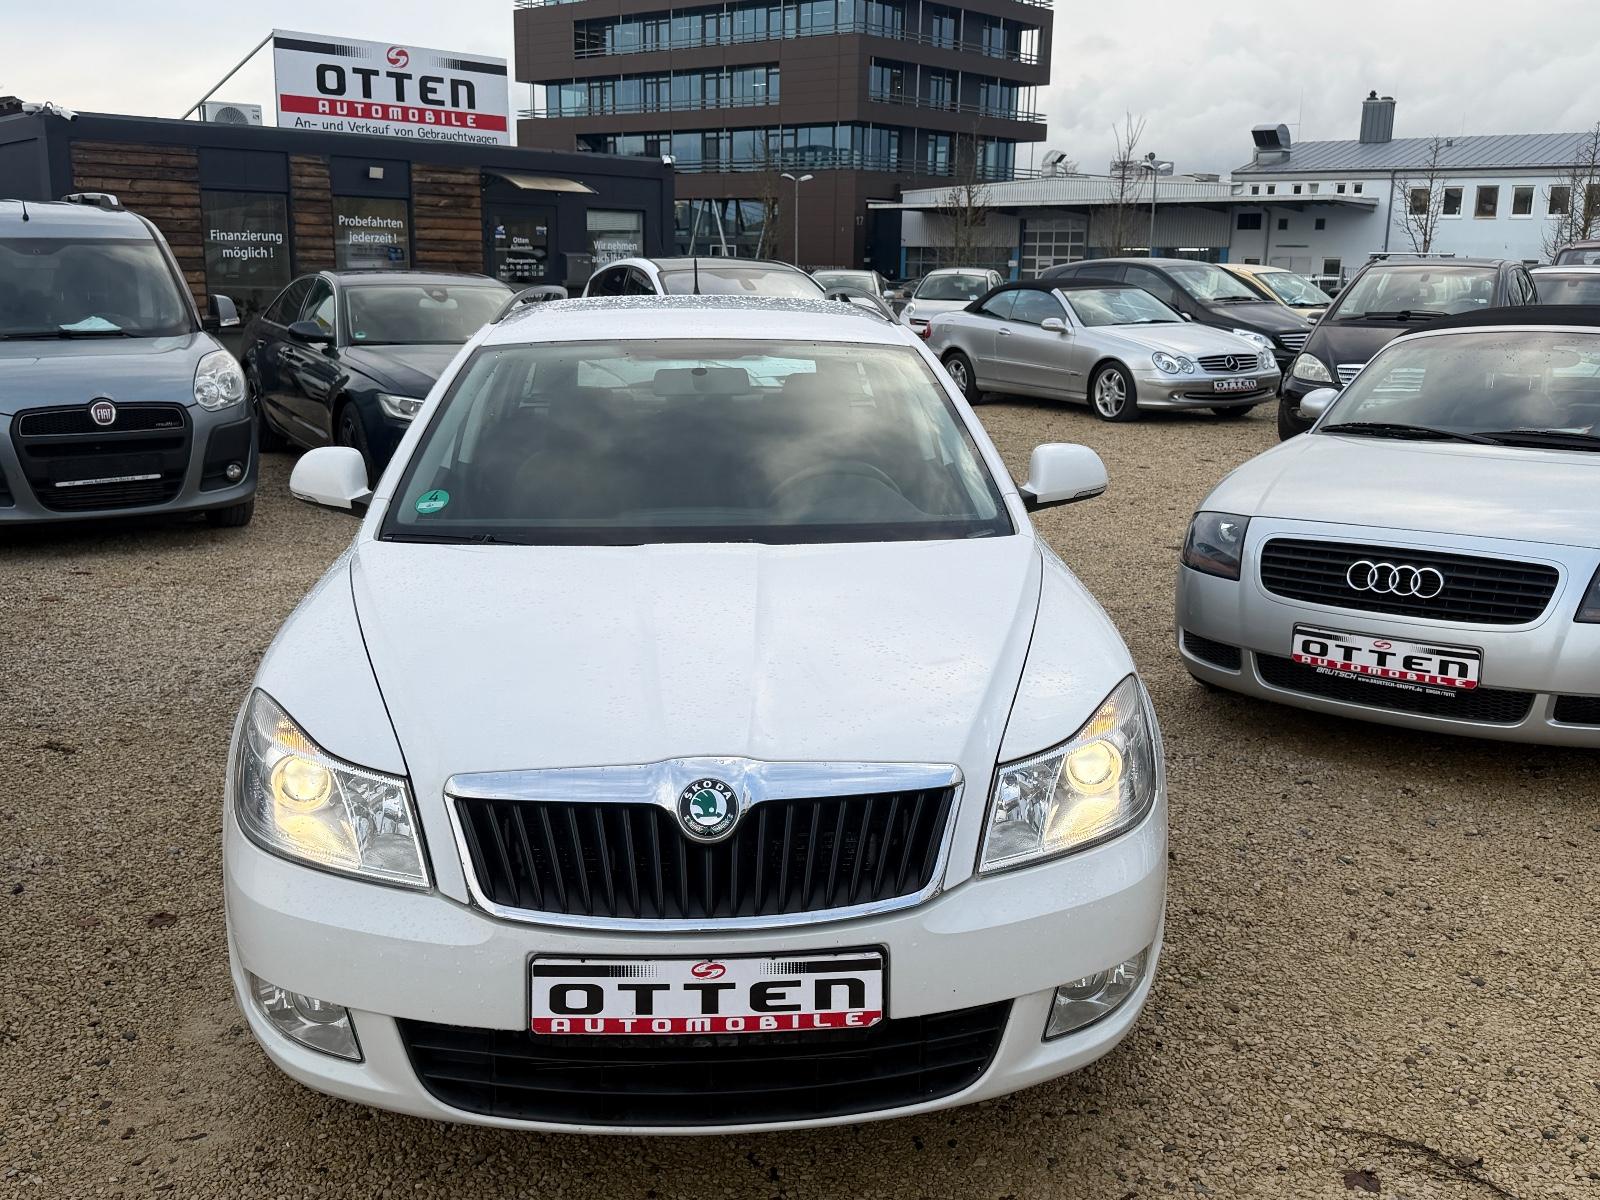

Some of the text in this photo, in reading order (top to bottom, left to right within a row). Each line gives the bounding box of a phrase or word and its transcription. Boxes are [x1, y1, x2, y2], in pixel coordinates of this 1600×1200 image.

[316, 63, 476, 110] OTTEN
[318, 100, 477, 127] AUTOMOBILE
[294, 117, 498, 145] An- und Verkauf von Gebrauchtwagen
[338, 215, 404, 229] Probefahrten
[210, 229, 283, 244] Finanzierung
[349, 231, 392, 245] jederzeit
[593, 240, 638, 251] Wir nehmen
[222, 246, 268, 261] möglich
[1216, 380, 1256, 388] OTTEN
[96, 408, 111, 420] FIAT
[428, 490, 439, 502] 4
[1301, 639, 1469, 679] OTTEN
[1301, 656, 1467, 688] AUTOMOBILE
[548, 977, 866, 1016] OTTEN
[550, 1011, 865, 1033] AUTOMOBILE
